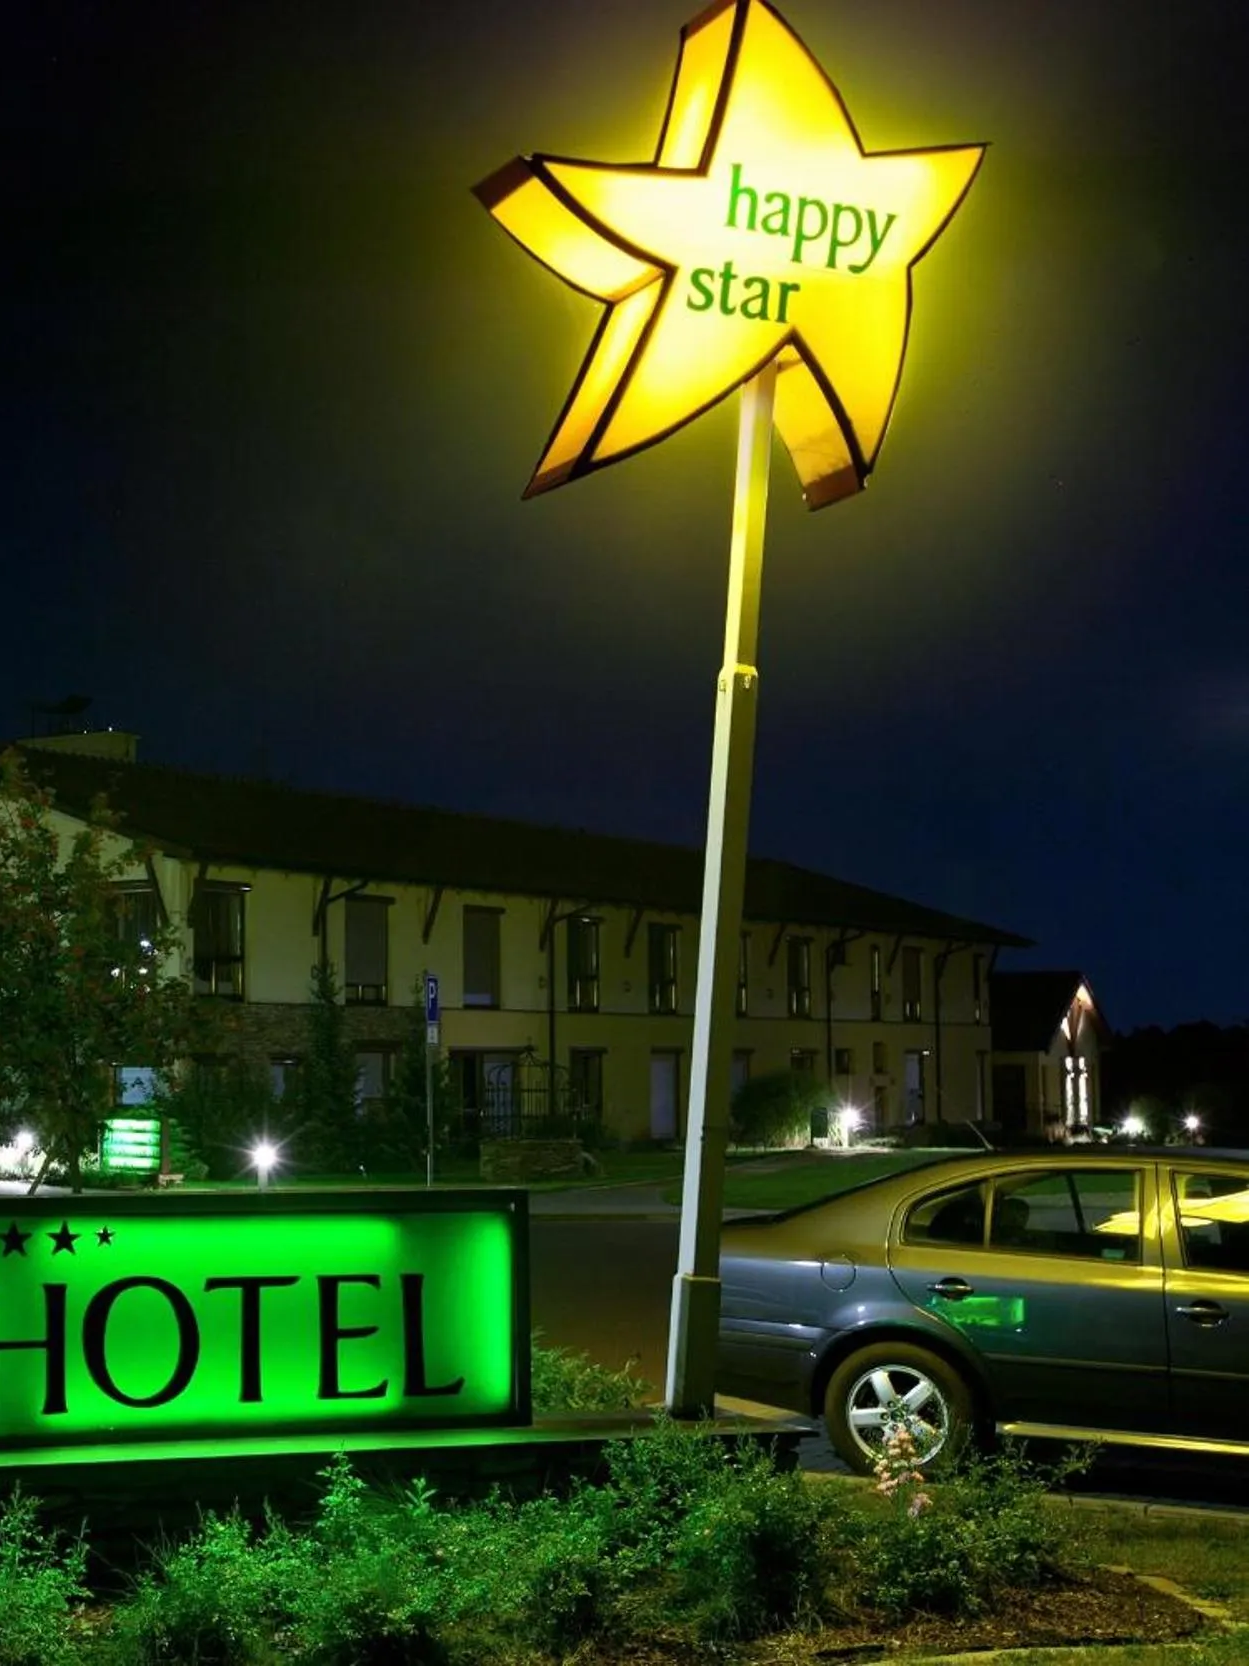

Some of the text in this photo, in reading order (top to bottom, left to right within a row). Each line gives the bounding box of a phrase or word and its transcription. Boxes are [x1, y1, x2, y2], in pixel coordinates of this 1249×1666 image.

[724, 163, 897, 273] happy
[686, 260, 801, 323] star
[429, 981, 437, 1009] P
